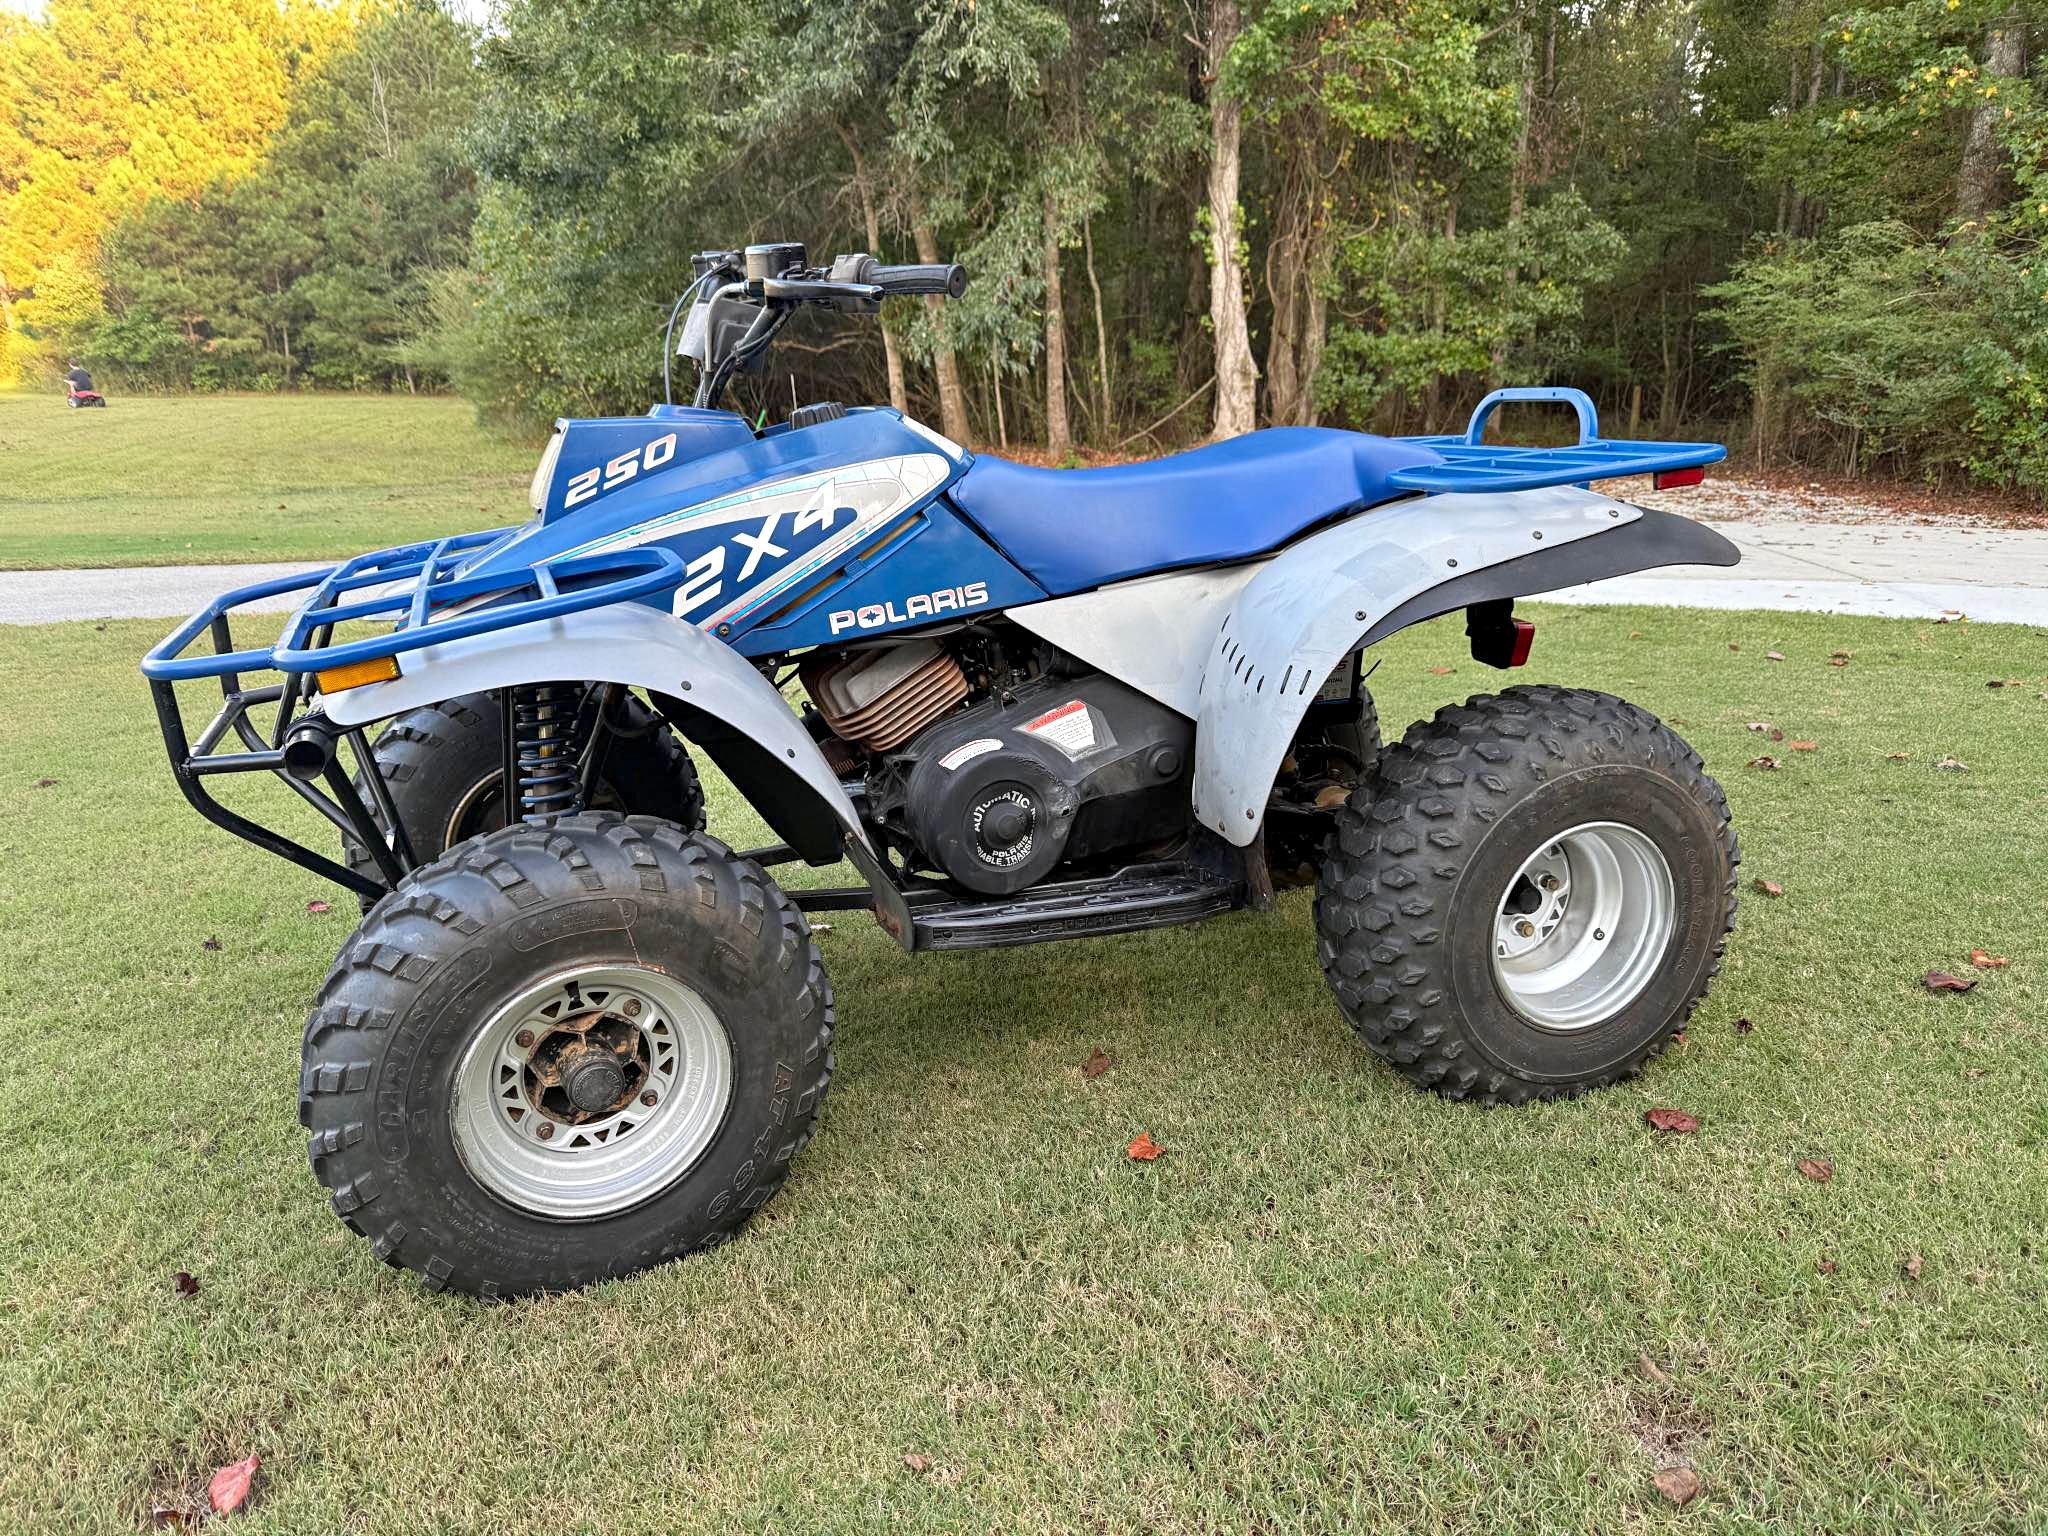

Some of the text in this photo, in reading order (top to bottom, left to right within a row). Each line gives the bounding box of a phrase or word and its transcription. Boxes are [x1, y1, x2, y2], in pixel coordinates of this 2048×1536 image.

[564, 433, 677, 509] 250
[828, 582, 989, 635] POLARIS
[992, 834, 1029, 858] POLARIS
